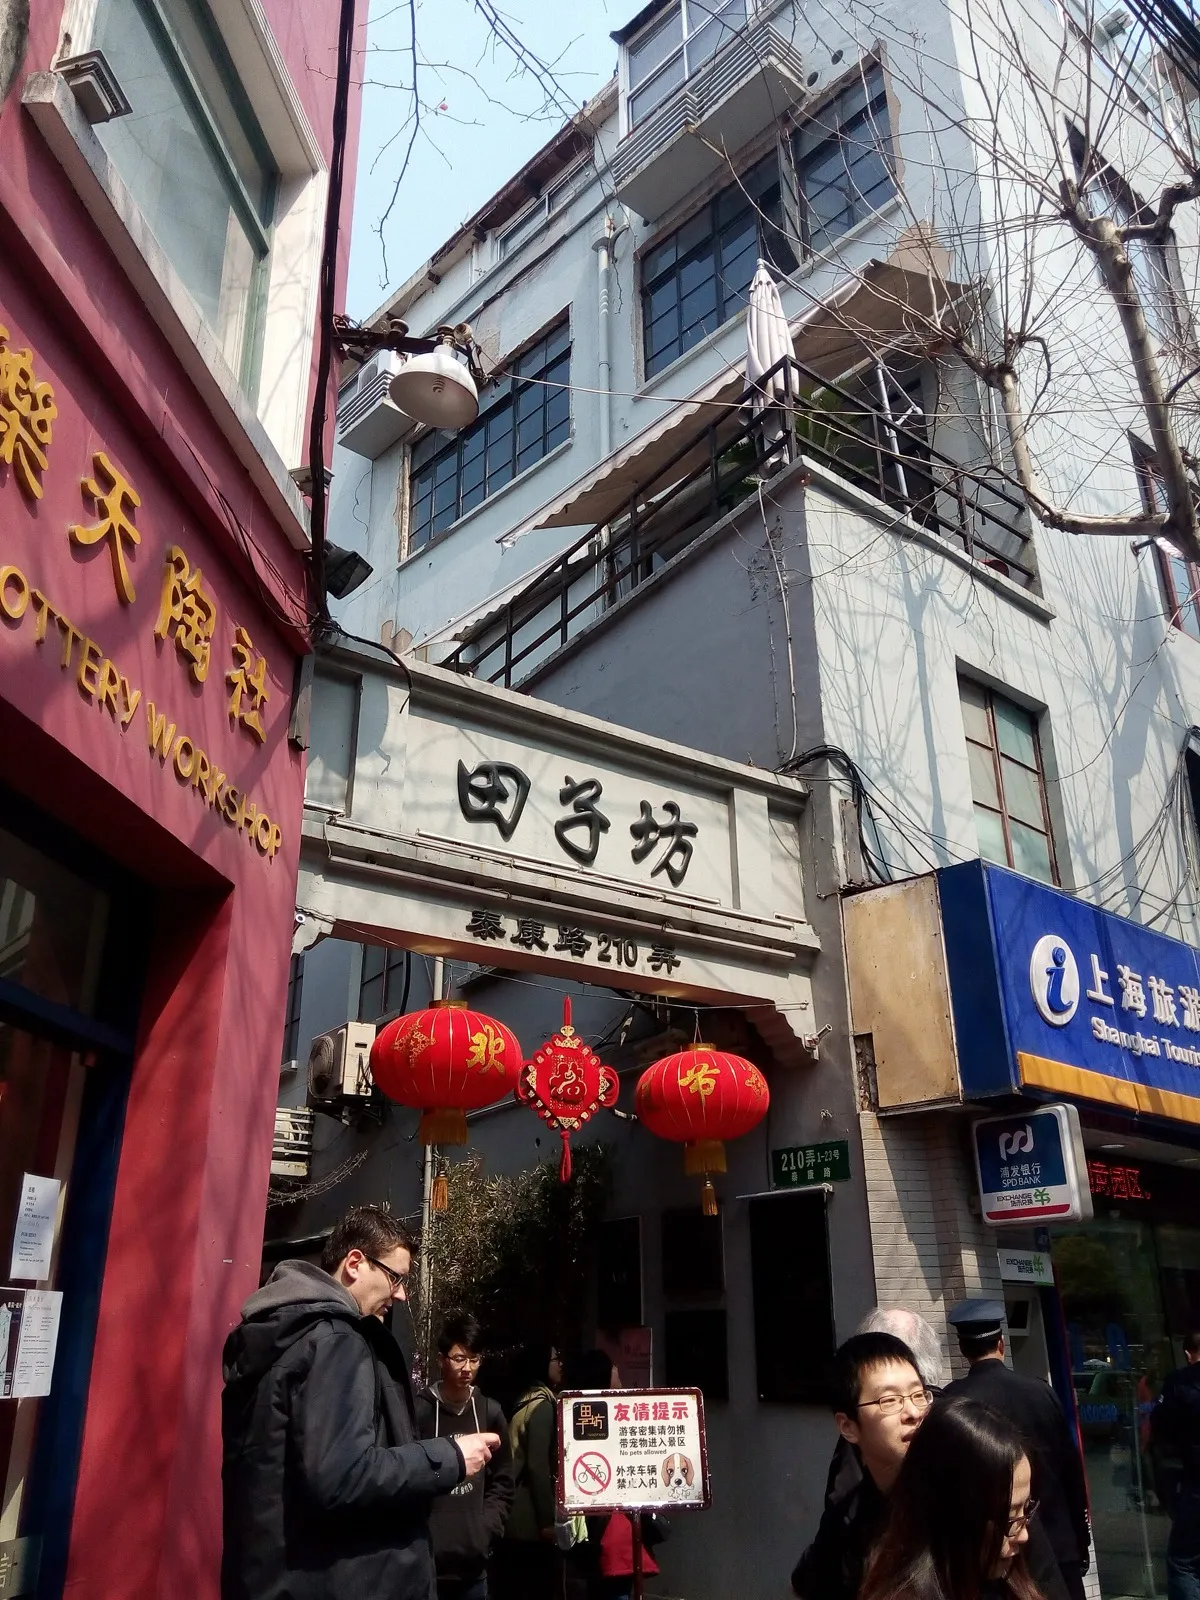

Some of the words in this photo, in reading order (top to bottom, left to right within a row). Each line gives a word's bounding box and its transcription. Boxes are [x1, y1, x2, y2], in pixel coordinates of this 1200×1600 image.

[148, 702, 282, 857] WORKSHOP
[457, 758, 699, 888] 田子坊
[465, 908, 681, 974] 泰康路210弄
[1090, 1016, 1161, 1056] Shanghai
[1000, 1162, 1041, 1178] 浦发银行
[1002, 1178, 1018, 1188] SPD
[1018, 1175, 1041, 1186] BANK
[997, 1192, 1032, 1202] EXCHANGE
[613, 1401, 689, 1422] 友情提示
[618, 1424, 686, 1437] 游客密集请勿携
[619, 1436, 686, 1449] 带宠物进入景区
[616, 1464, 658, 1477] 外来车辆
